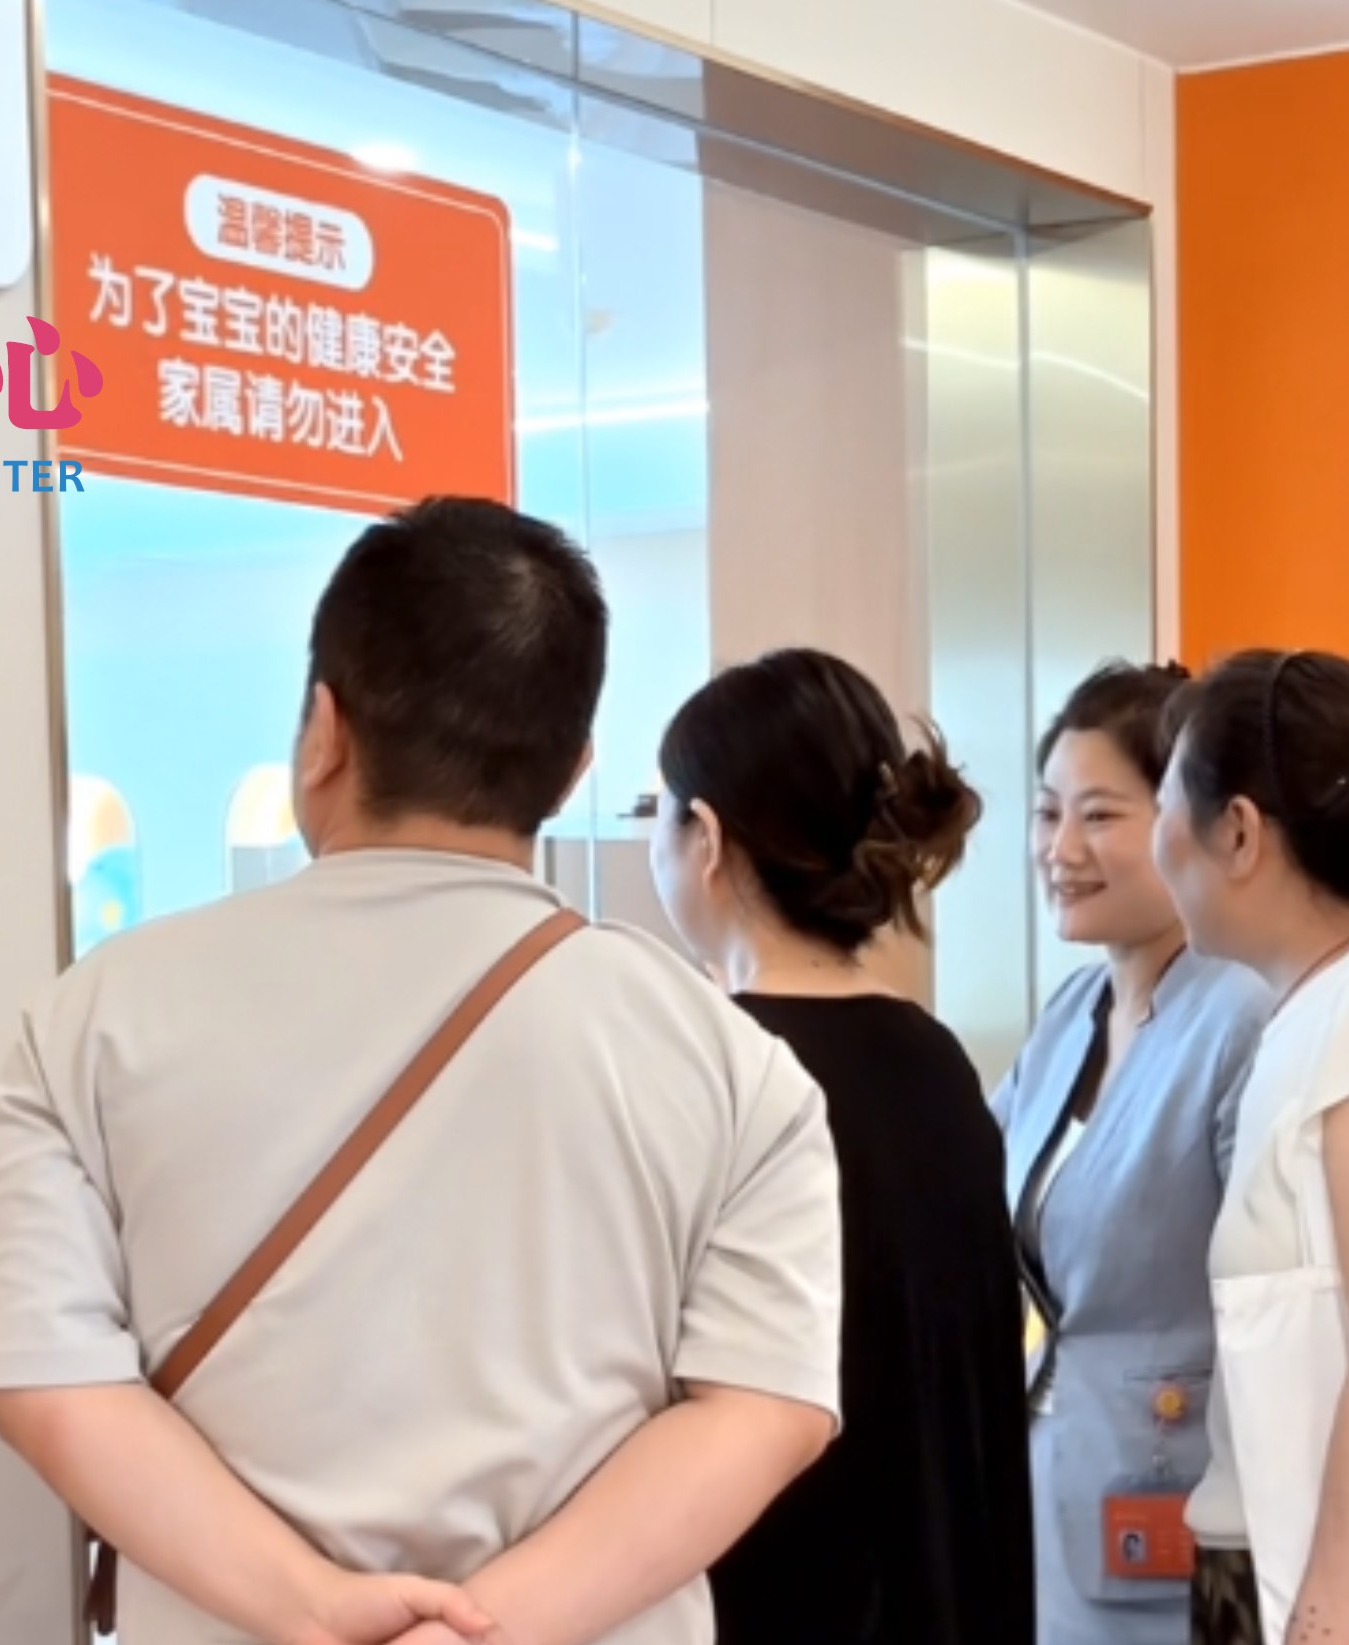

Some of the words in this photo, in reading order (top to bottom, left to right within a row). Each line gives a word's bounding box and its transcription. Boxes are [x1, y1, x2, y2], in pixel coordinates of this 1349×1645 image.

[216, 193, 347, 270] 温馨提示
[87, 251, 456, 394] 为了宝宝的健康安全
[157, 357, 403, 462] 家属请勿进入
